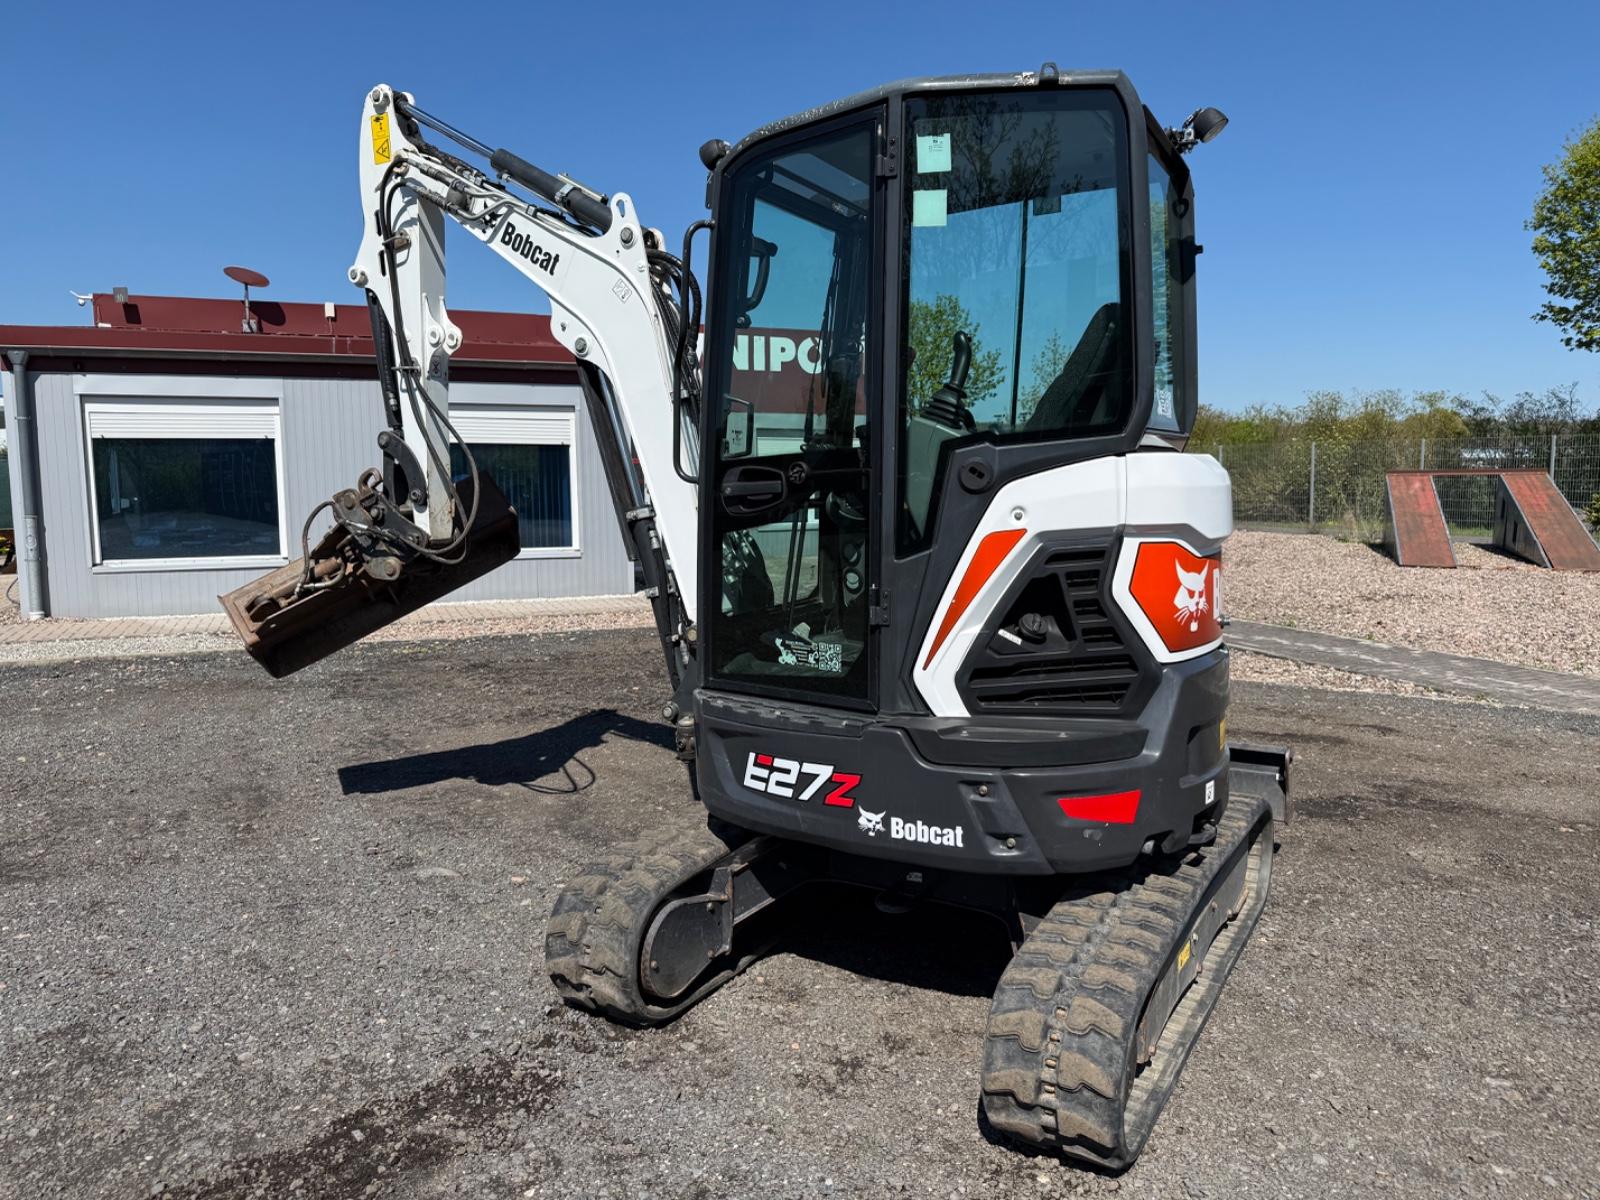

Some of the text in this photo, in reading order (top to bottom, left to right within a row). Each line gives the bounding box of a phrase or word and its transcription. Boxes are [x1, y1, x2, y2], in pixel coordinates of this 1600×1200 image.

[500, 221, 560, 276] Bobcat
[732, 334, 828, 375] NIPO
[890, 817, 964, 848] Bobcat
